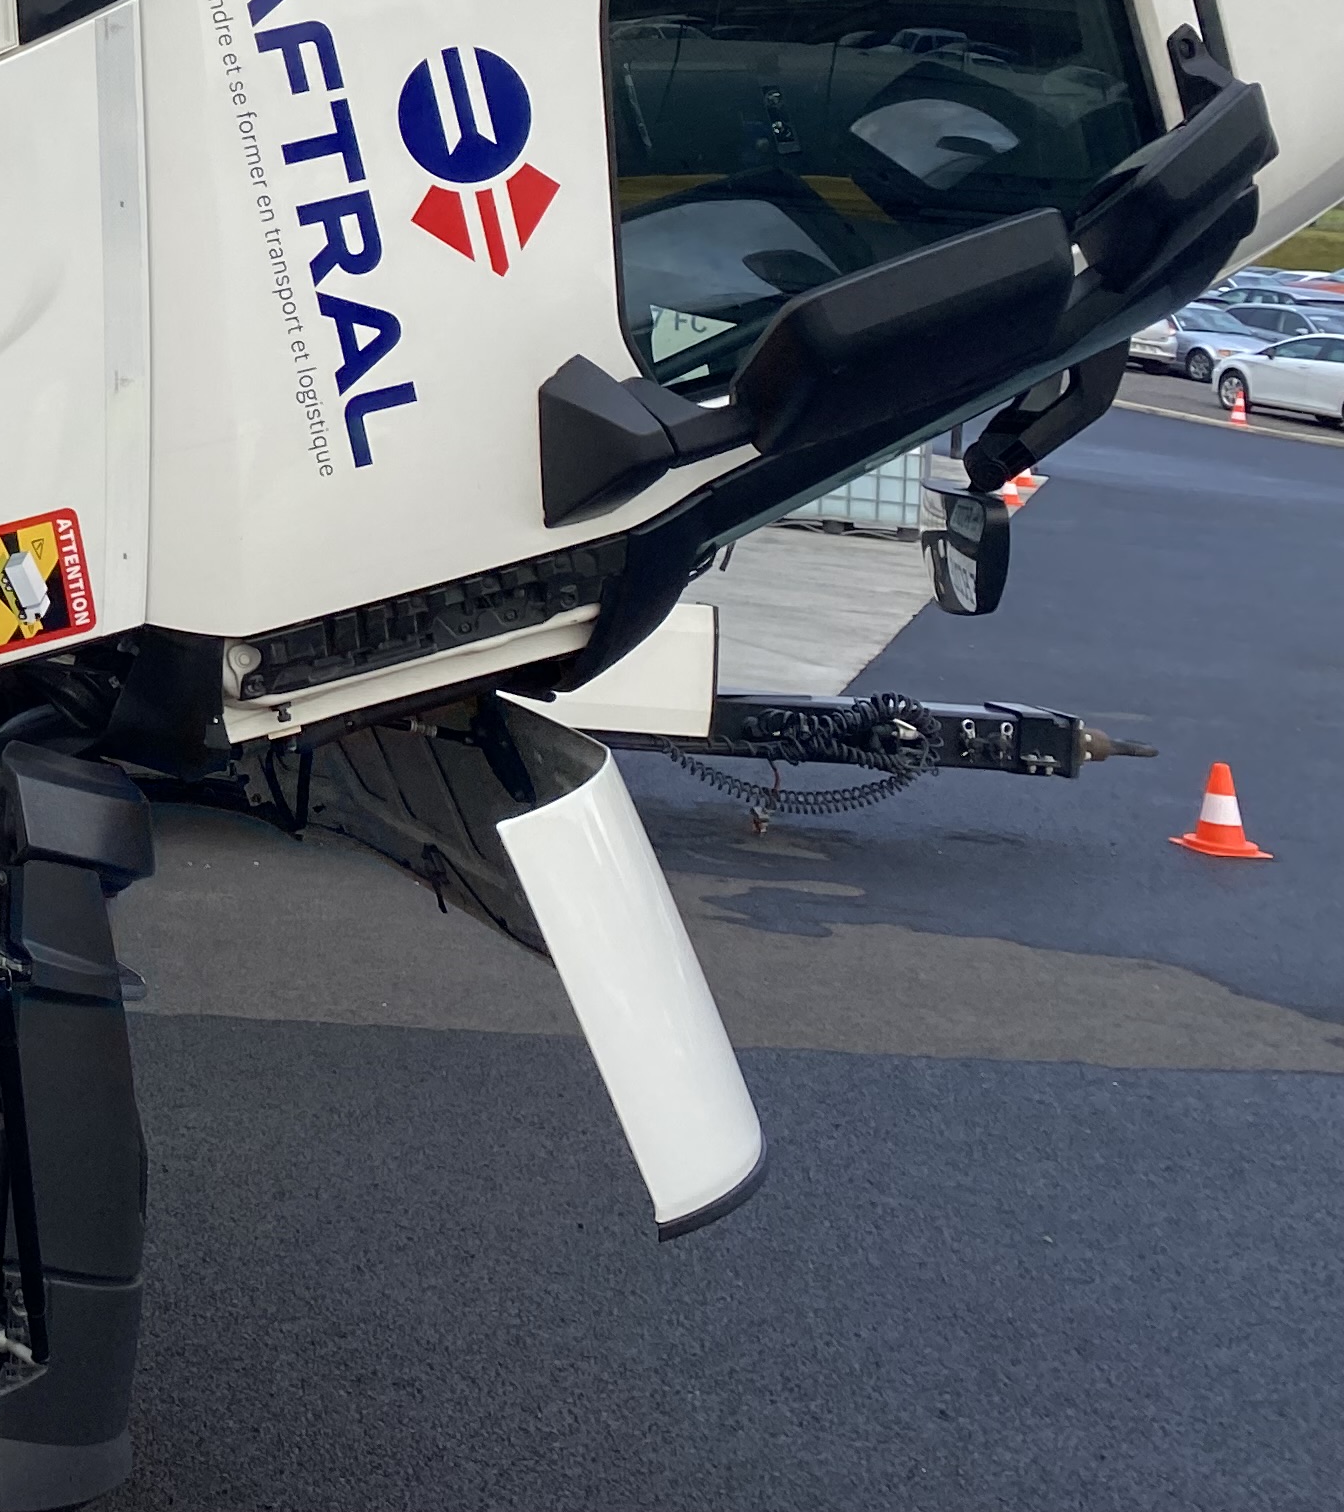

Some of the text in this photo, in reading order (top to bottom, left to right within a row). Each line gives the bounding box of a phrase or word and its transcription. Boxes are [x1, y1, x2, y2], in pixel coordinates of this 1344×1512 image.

[223, 54, 241, 75] et
[229, 80, 247, 106] se
[236, 111, 268, 188] former
[257, 195, 275, 222] en
[264, 228, 304, 335] transport
[291, 340, 309, 363] et
[296, 367, 334, 477] logistique
[56, 519, 91, 626] ATTENTION
